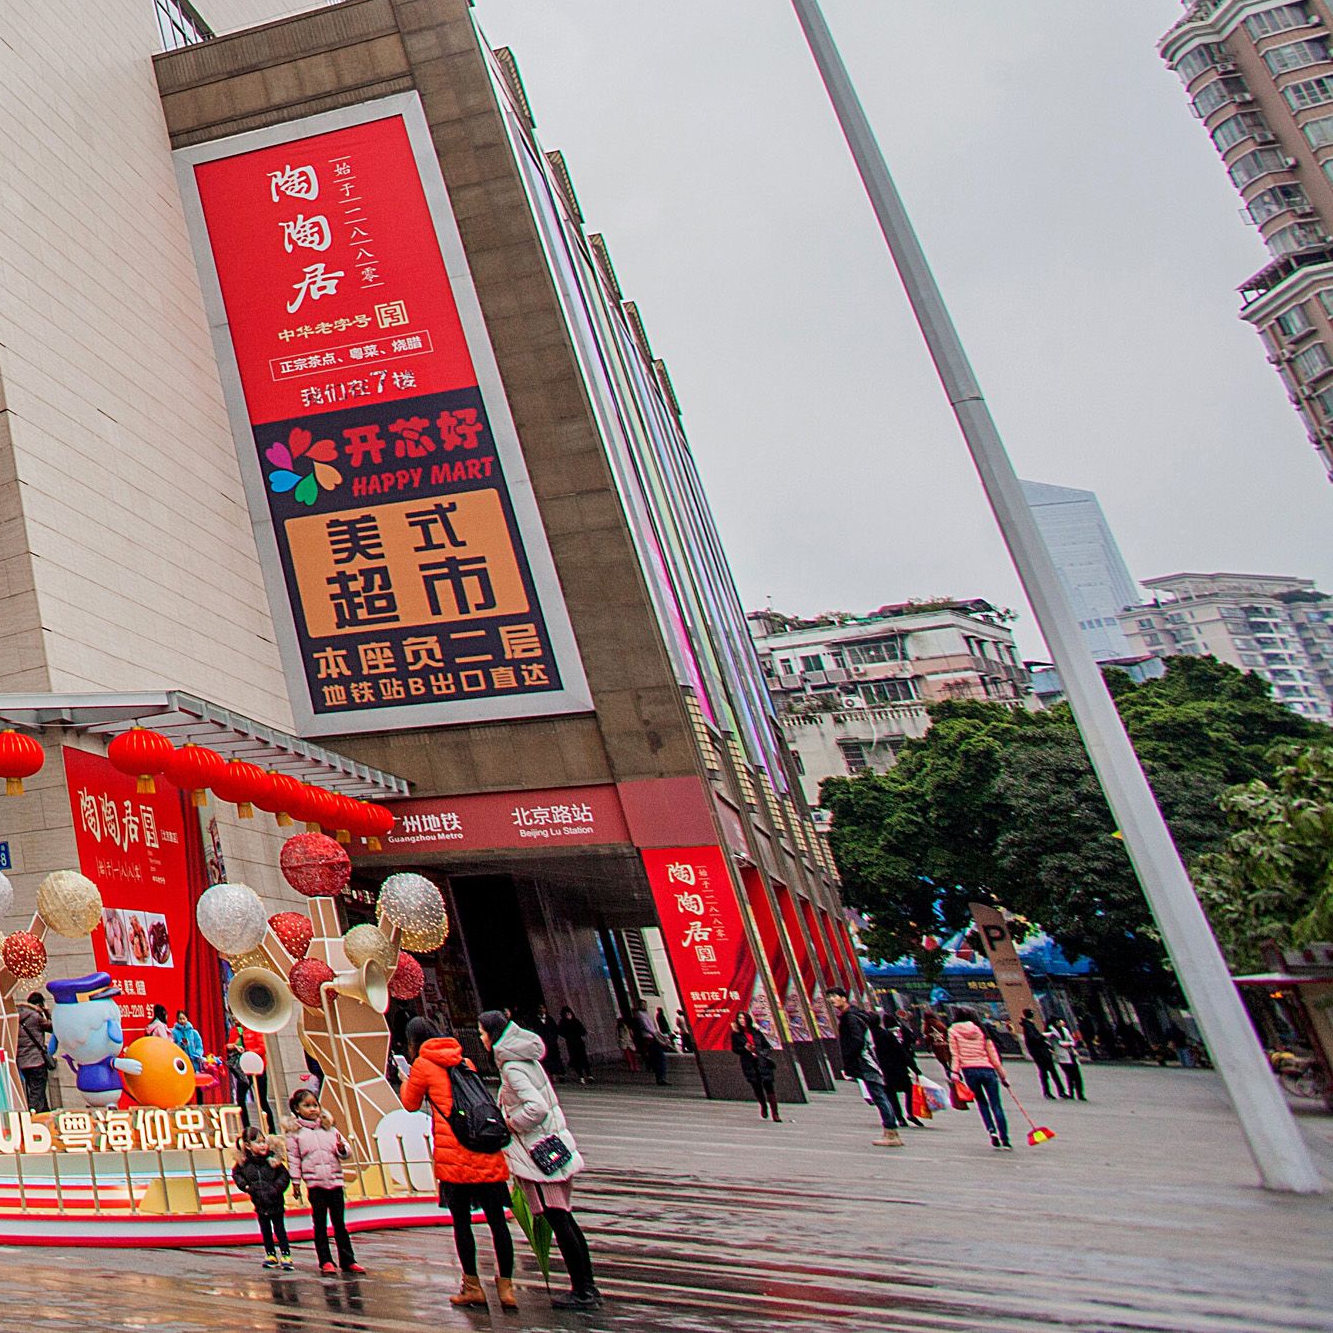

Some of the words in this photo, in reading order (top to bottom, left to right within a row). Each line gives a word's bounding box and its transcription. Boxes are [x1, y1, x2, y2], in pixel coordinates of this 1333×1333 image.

[266, 164, 344, 314] 陶陶居
[277, 313, 372, 342] 中华老字号
[300, 369, 417, 407] 我们在7楼
[342, 408, 483, 468] 开芯好
[352, 468, 423, 498] HAPPY
[430, 456, 495, 485] MART
[326, 502, 467, 564] 美式
[326, 555, 498, 631] 超市
[312, 623, 544, 679] 本座负二层
[321, 663, 550, 707] 地铁站B出口直达
[77, 787, 139, 852] 陶陶居
[388, 833, 436, 844] Guangzhou
[437, 832, 464, 841] Metro
[520, 828, 549, 839] Beijing
[550, 827, 562, 836] Lu
[563, 825, 594, 835] Station
[511, 803, 594, 827] 北京路站
[665, 861, 713, 947] 陶陶居
[982, 924, 1007, 952] P
[58, 1106, 243, 1153] 粤海仰忠汇
